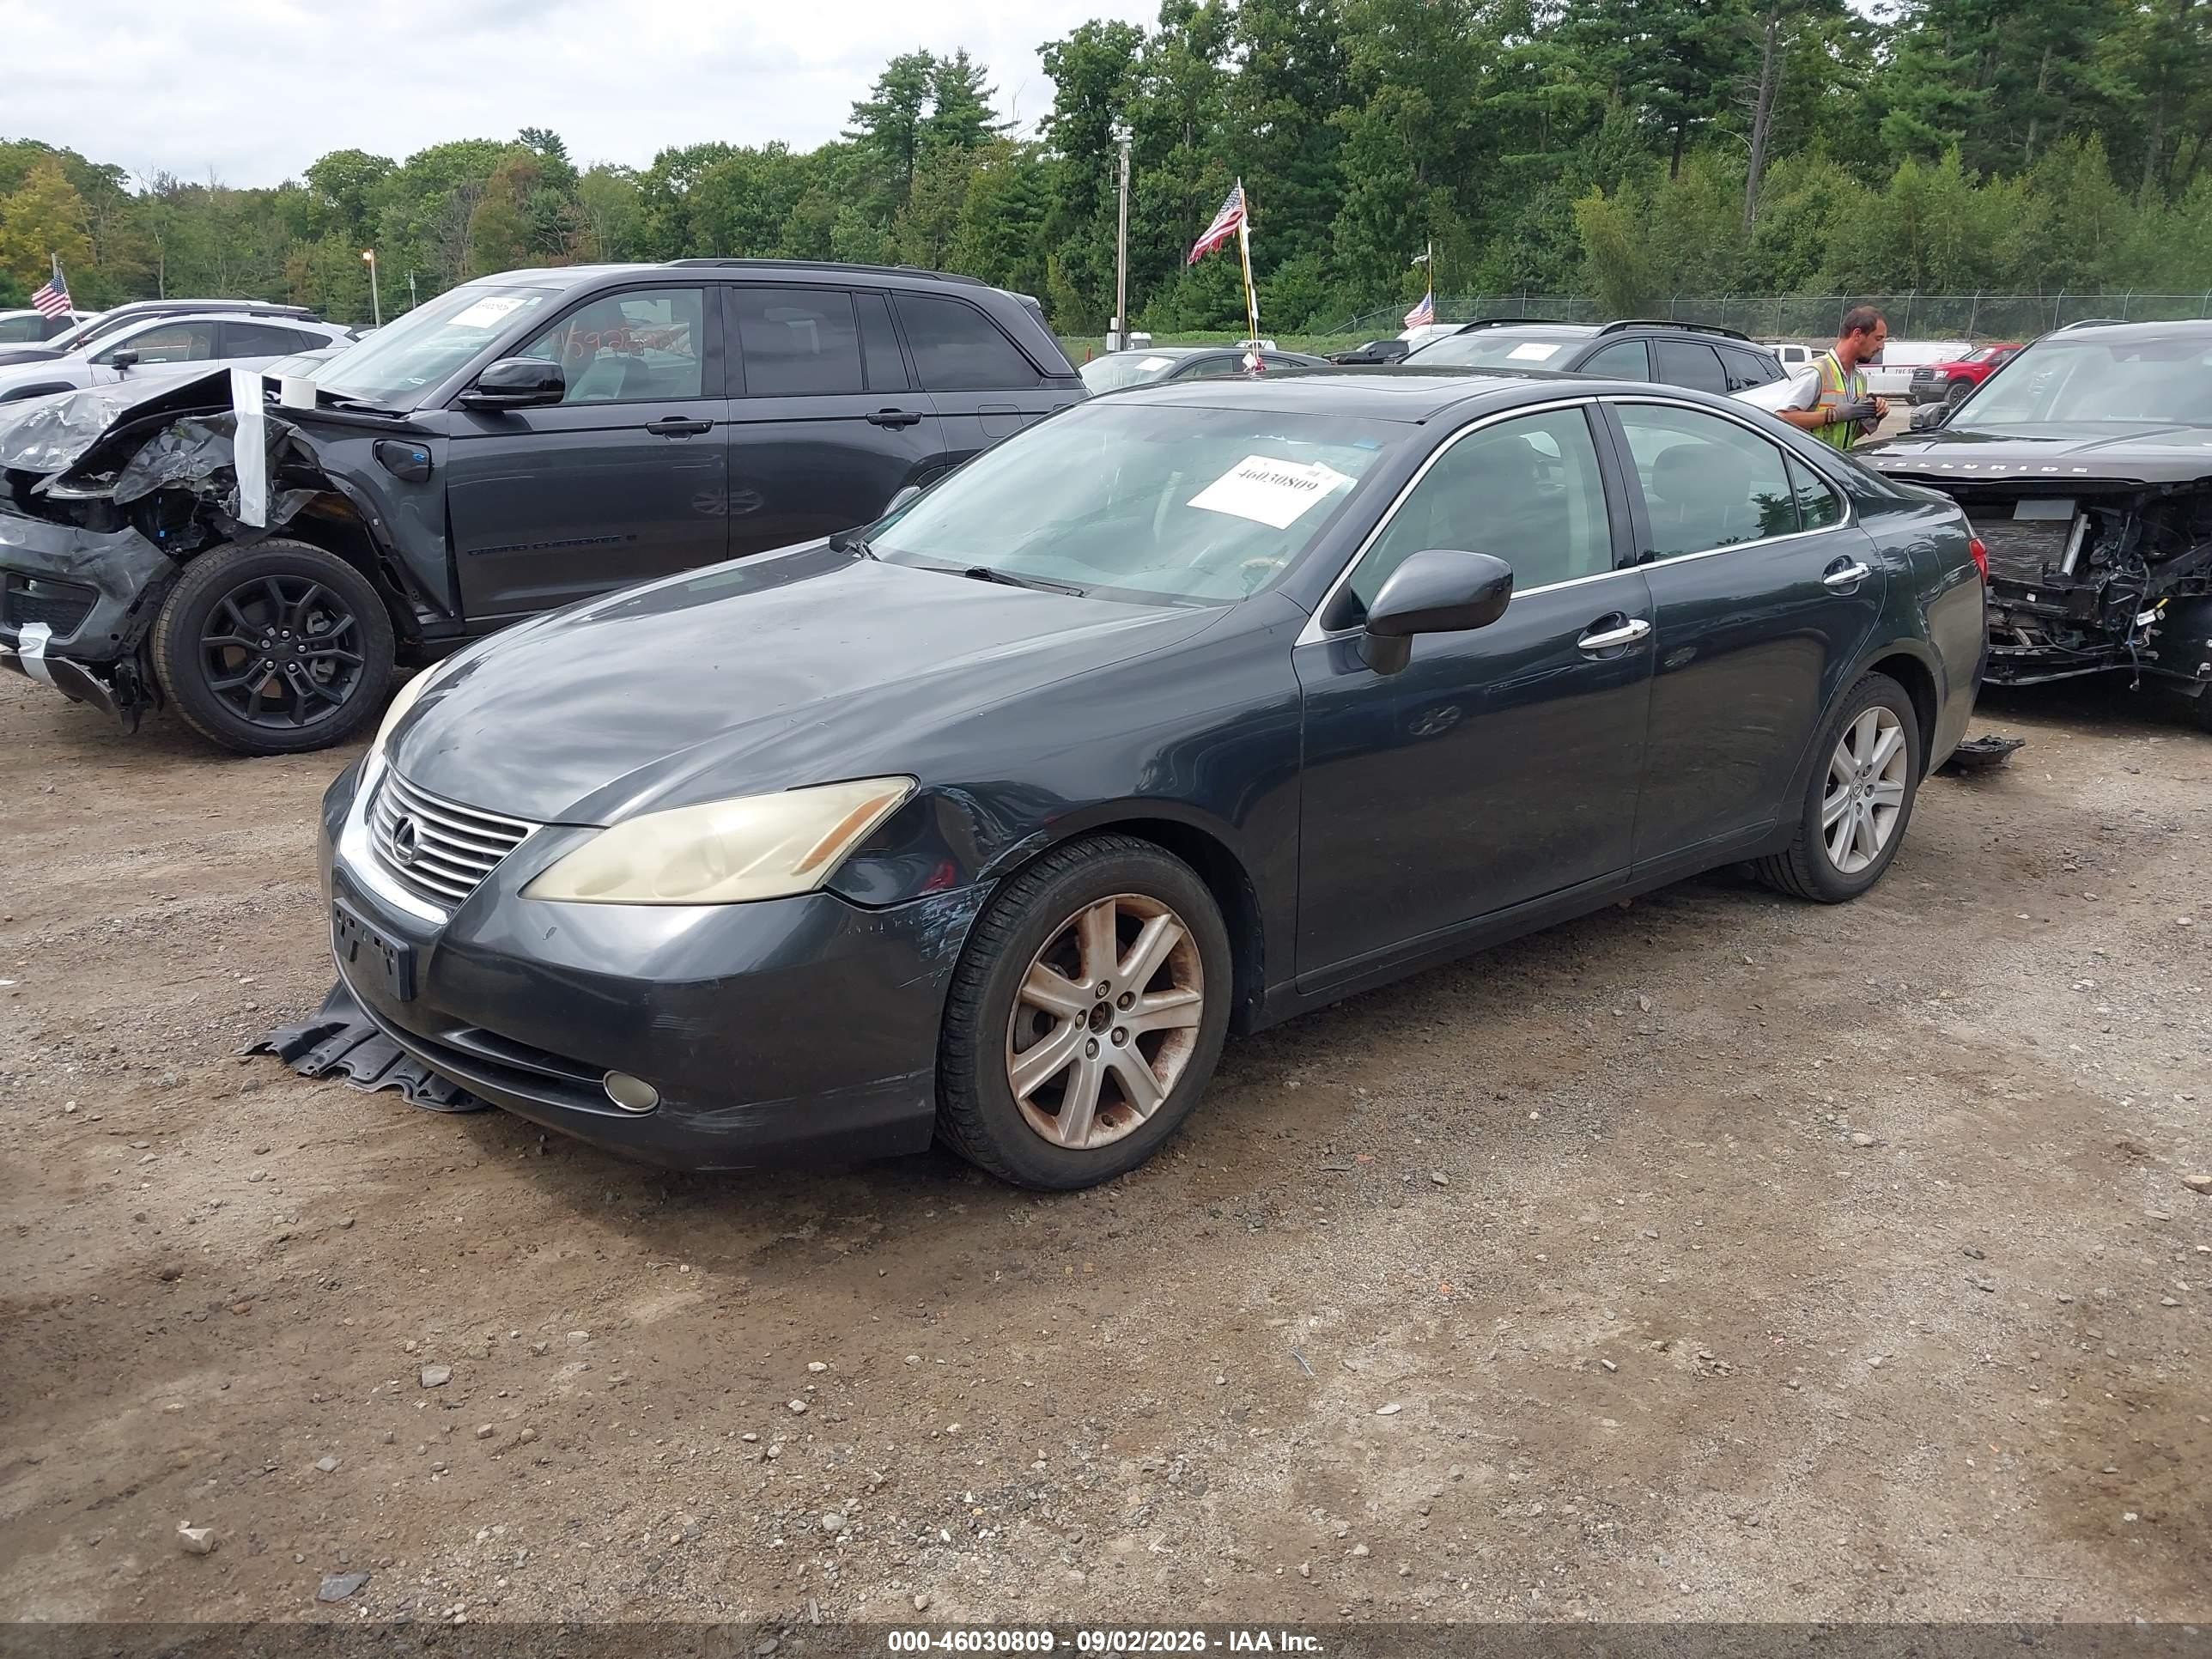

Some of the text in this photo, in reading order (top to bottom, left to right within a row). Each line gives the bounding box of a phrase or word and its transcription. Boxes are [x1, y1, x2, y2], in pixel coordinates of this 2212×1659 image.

[1876, 462, 2088, 473] TELLURIDE
[1237, 468, 1319, 492] 46030809
[533, 535, 622, 550] CHEROKEE
